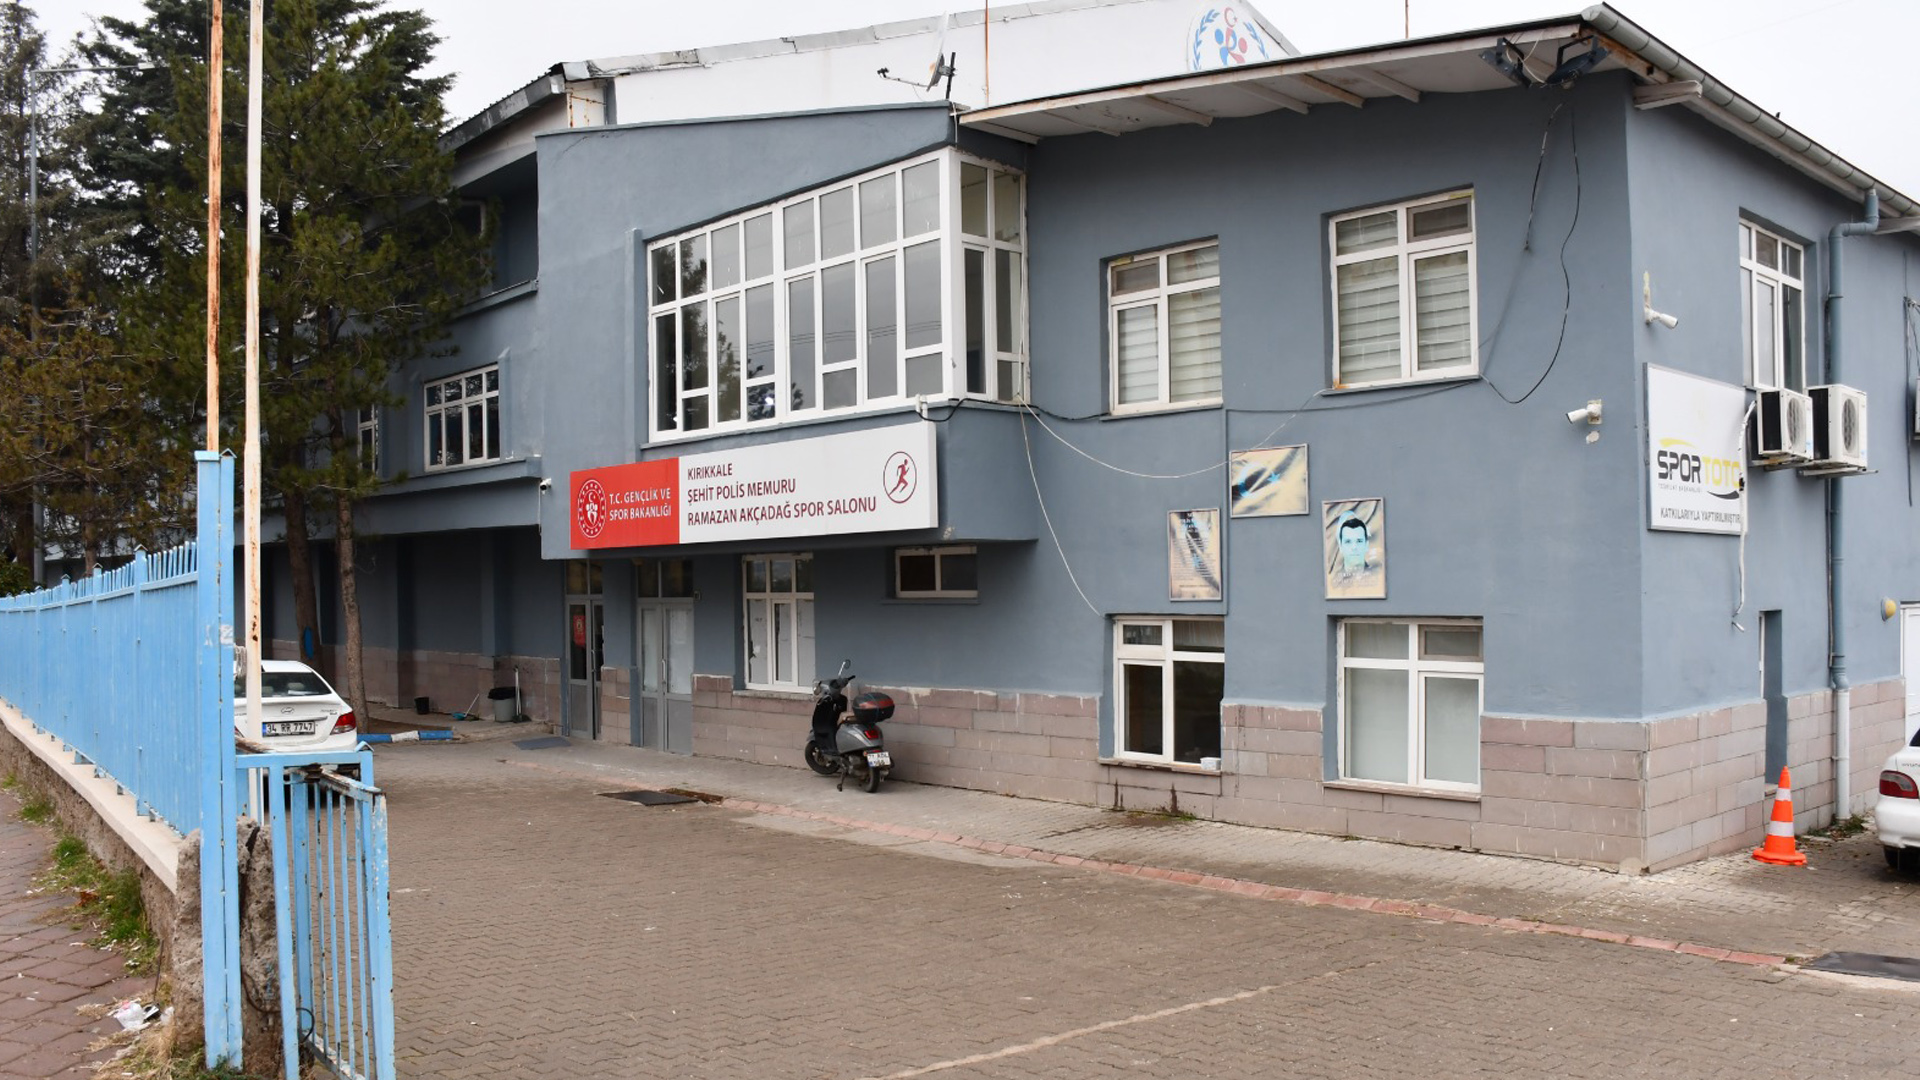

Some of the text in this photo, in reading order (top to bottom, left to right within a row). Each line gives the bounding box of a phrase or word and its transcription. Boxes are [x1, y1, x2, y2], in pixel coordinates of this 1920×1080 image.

[687, 463, 733, 481] KIRIKKALE
[609, 487, 671, 505] T.C. GENÇLİK VE
[687, 478, 796, 506] ŞEHİT POLİS MEMURU
[609, 502, 672, 521] SPOR BAKANLIĞI
[687, 496, 877, 526] RAMAZAN AKÇADAĞ SPOR SALONU
[267, 723, 277, 733] 34
[294, 722, 313, 732] 7747
